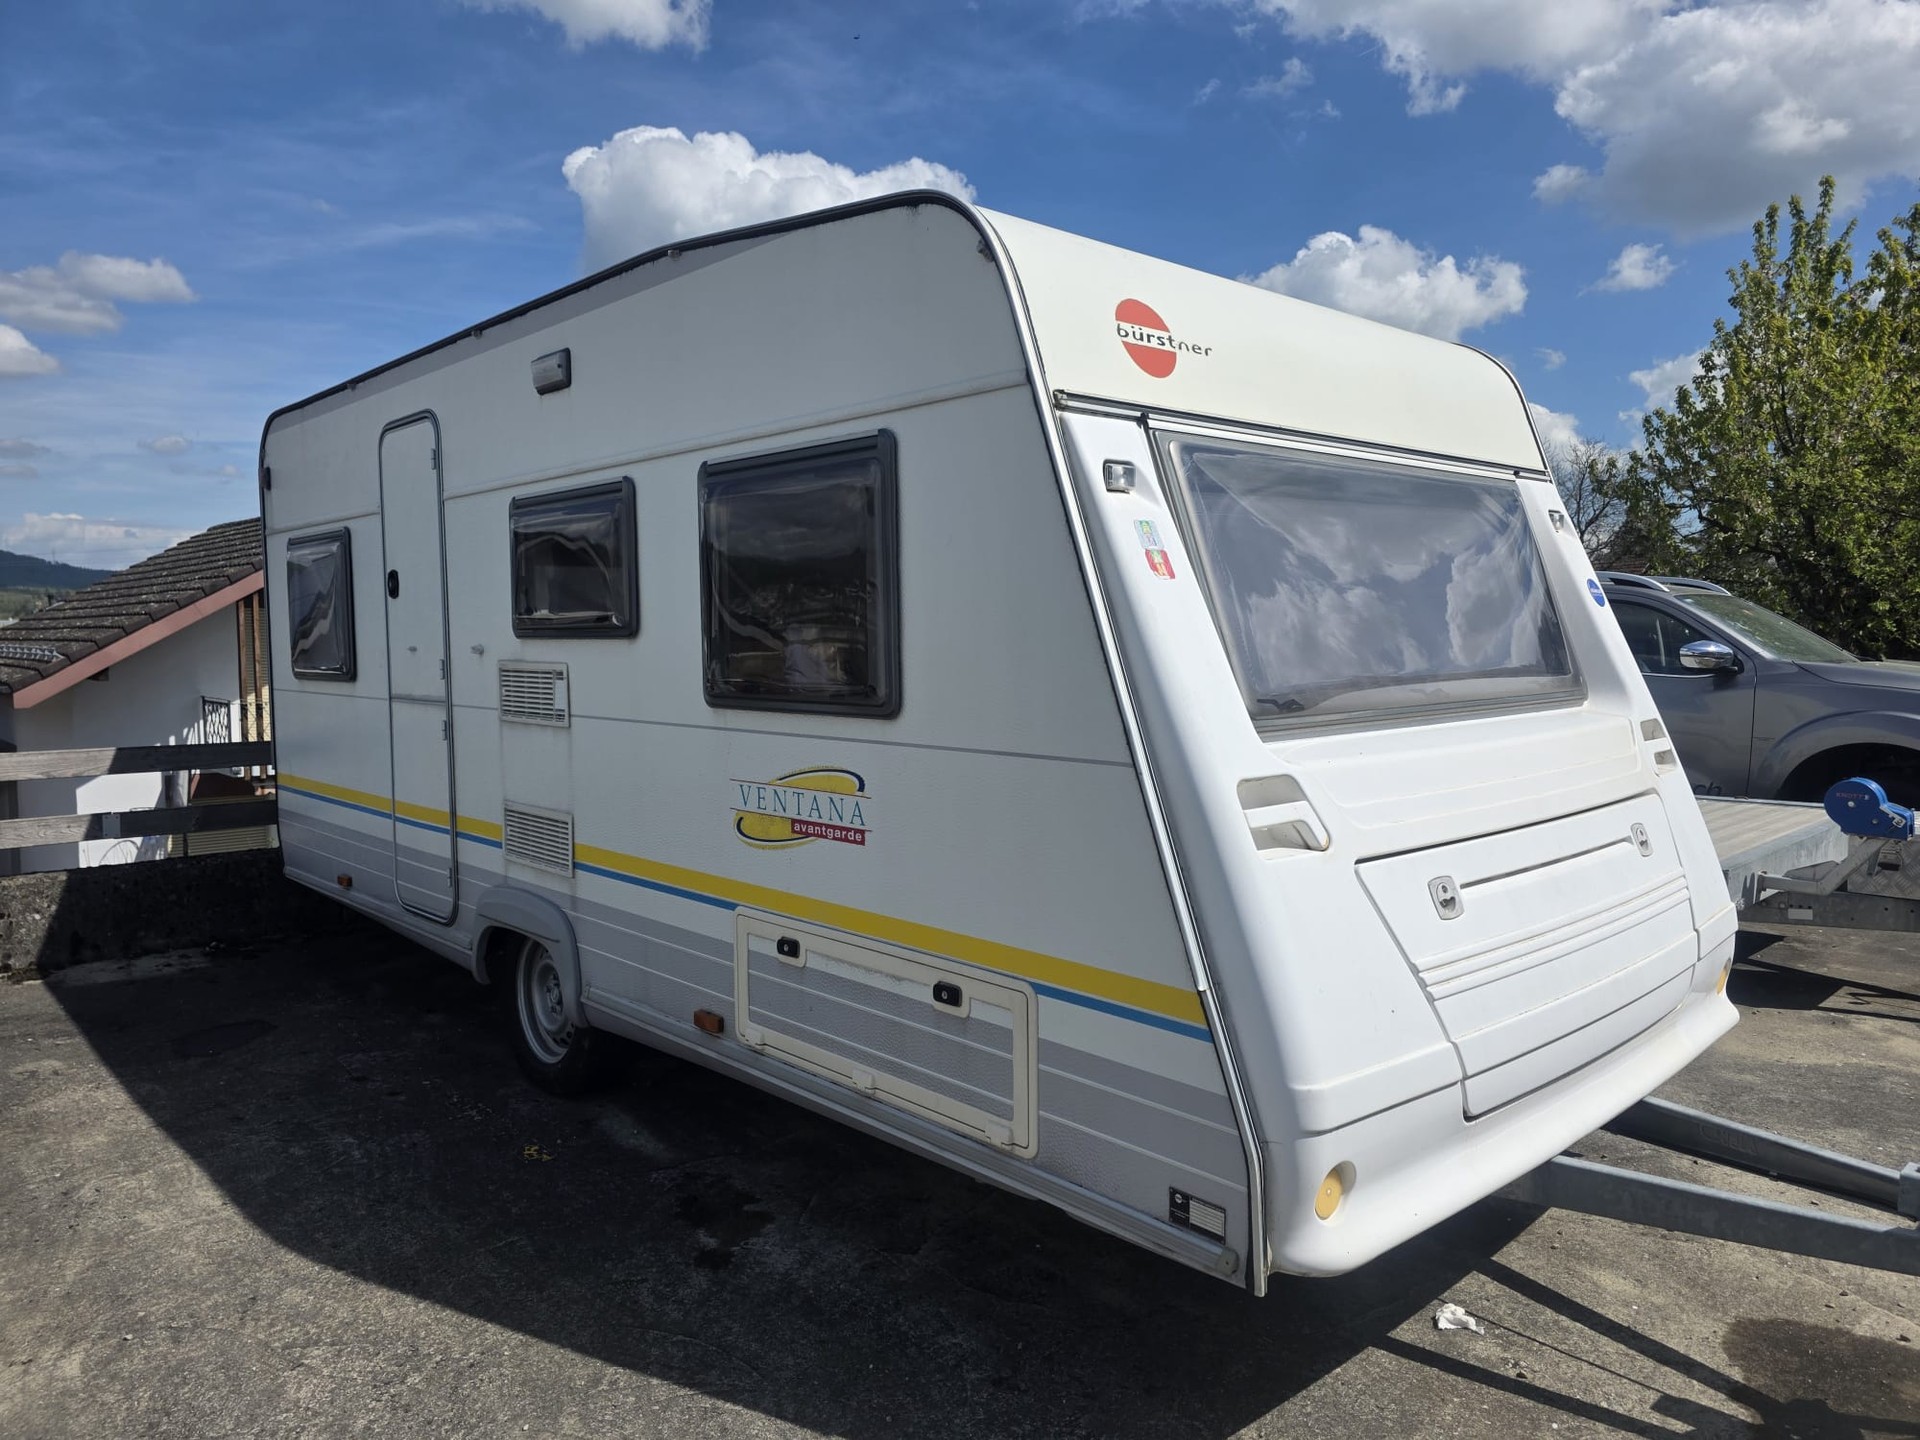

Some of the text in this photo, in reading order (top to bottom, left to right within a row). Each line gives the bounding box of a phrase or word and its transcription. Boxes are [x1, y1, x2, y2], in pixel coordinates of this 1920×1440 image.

[1116, 323, 1212, 356] bürstner
[739, 784, 865, 826] VENTANA
[793, 822, 862, 841] avantgarde
